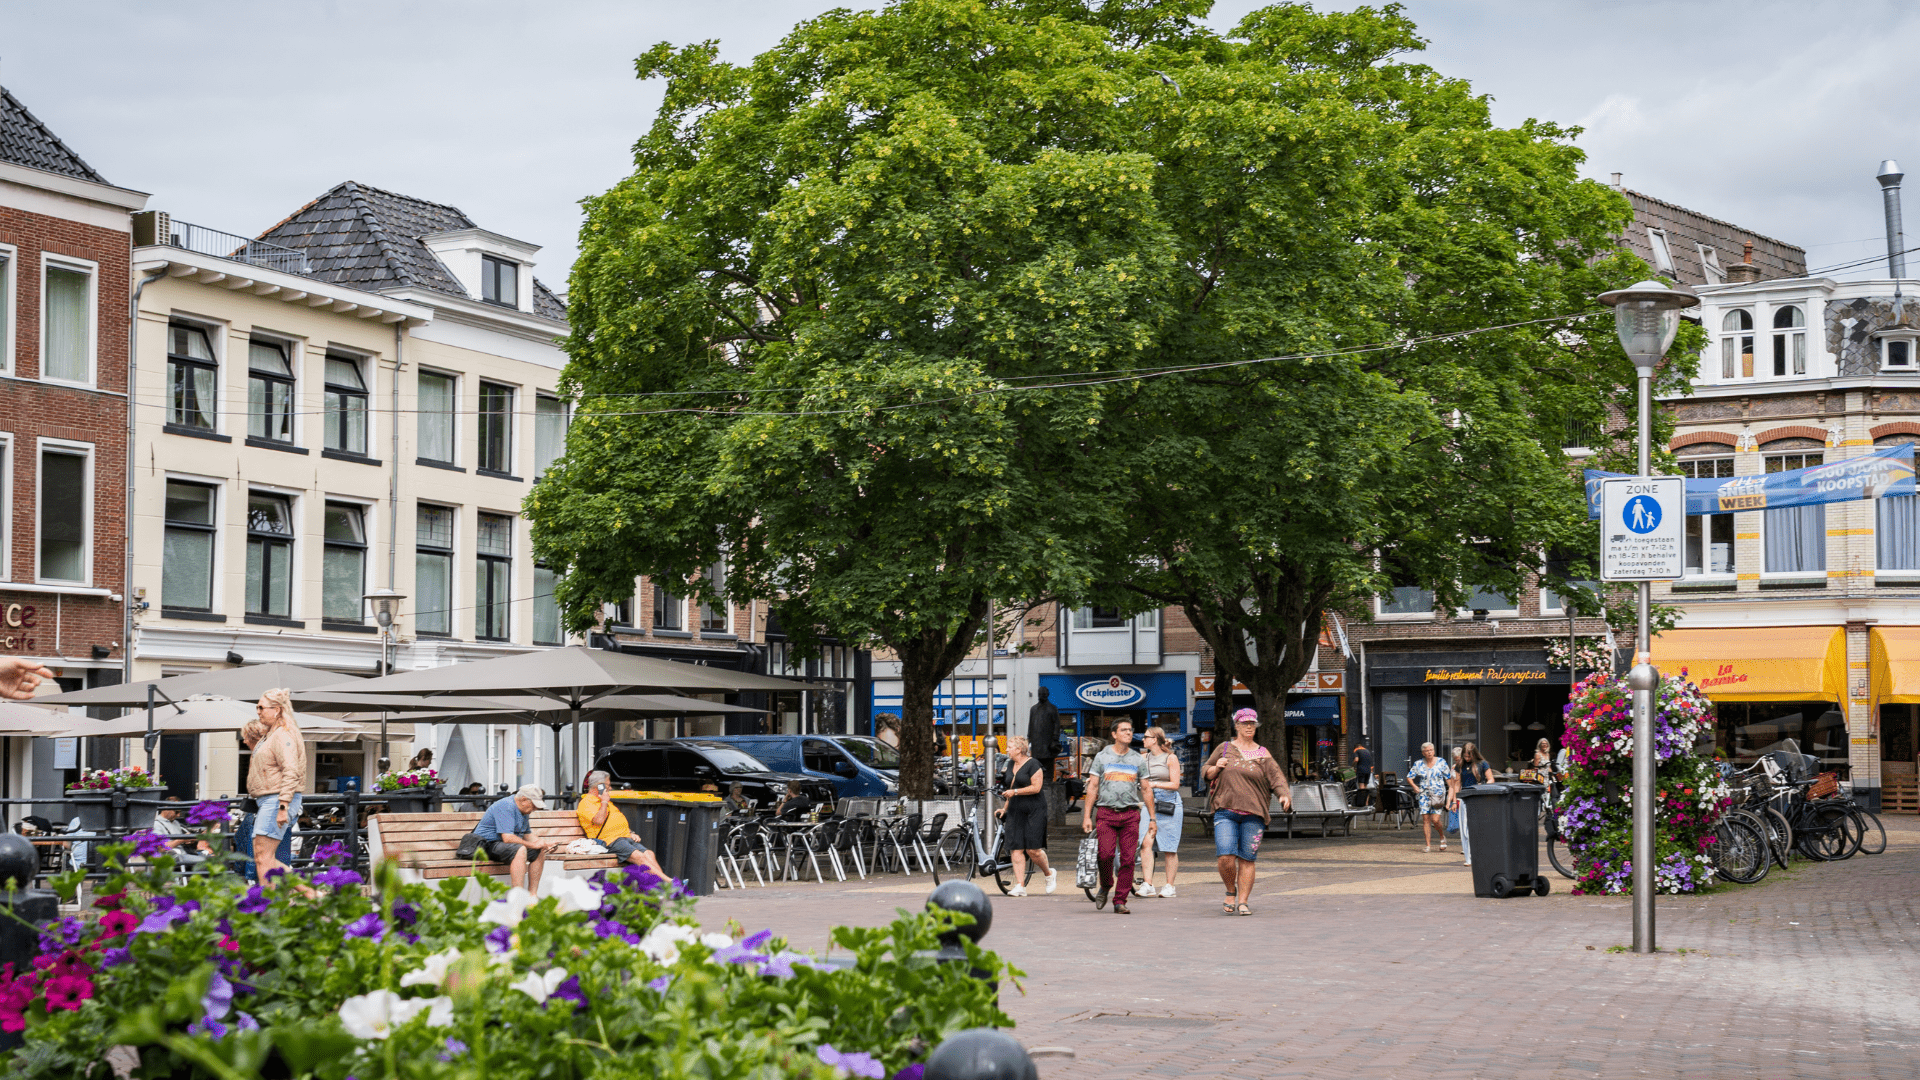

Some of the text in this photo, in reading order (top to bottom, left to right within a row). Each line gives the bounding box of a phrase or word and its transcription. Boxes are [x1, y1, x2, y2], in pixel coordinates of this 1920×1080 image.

[1626, 484, 1658, 494] ZONE
[1817, 473, 1890, 493] KOOPSTAD
[1717, 484, 1766, 497] SNEEK
[1721, 496, 1764, 509] WEEK
[0, 603, 37, 628] ce
[1085, 688, 1132, 698] trekpleister
